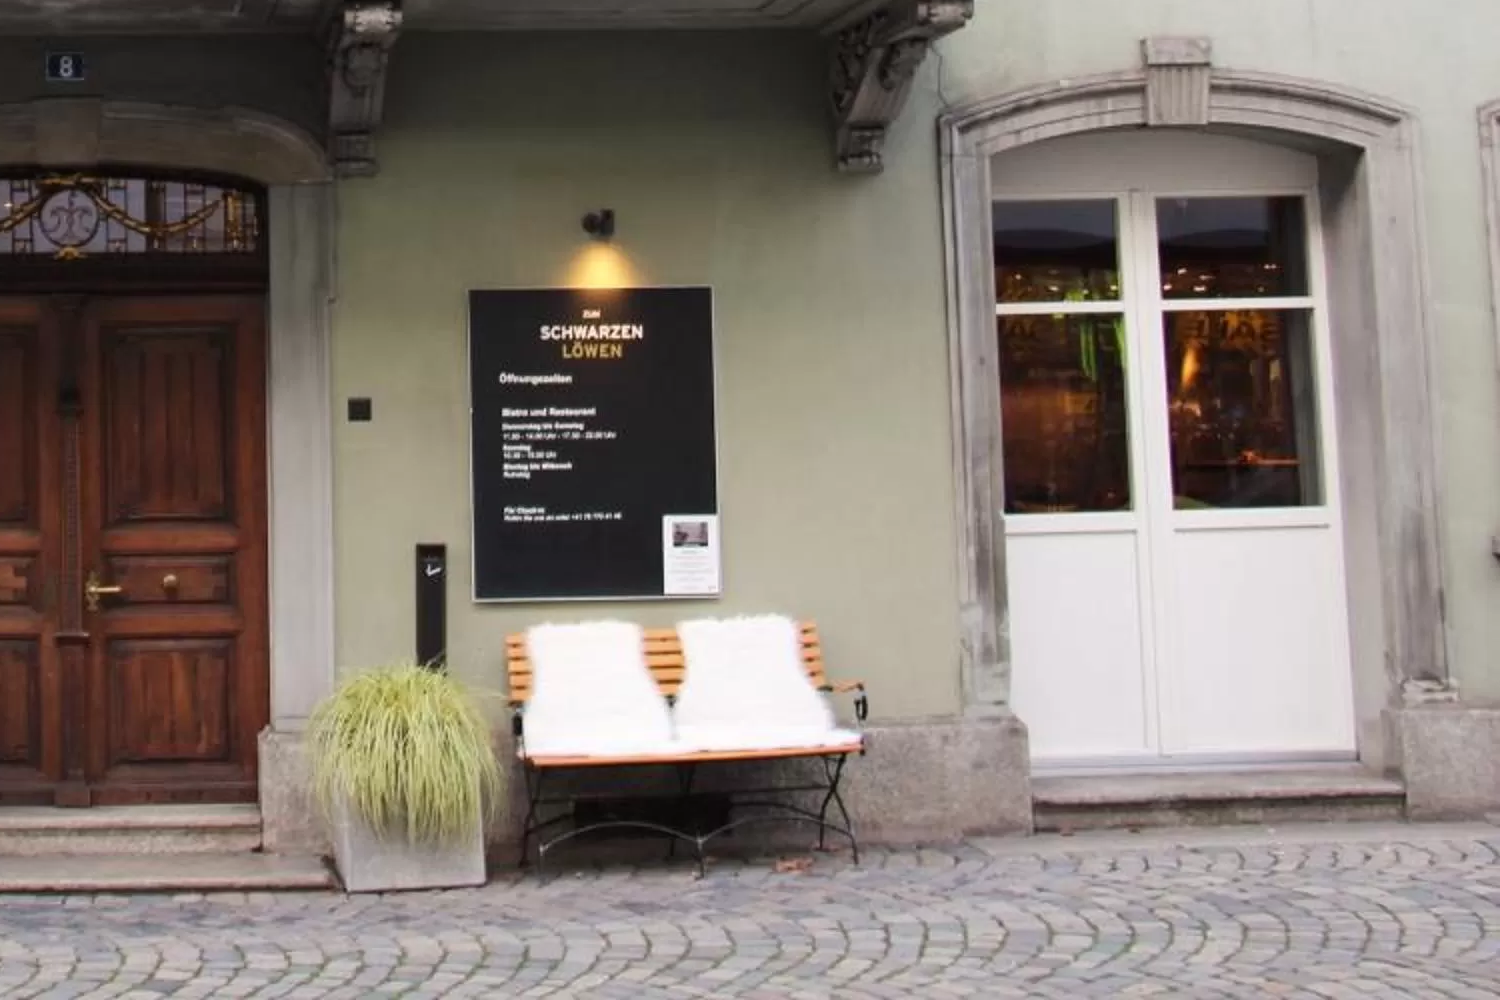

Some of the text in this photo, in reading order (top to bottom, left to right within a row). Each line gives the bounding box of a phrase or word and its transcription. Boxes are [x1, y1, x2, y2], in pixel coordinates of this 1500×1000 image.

[59, 55, 73, 77] 8
[540, 324, 644, 340] SCHWARZEN
[562, 341, 623, 359] LÖWEN
